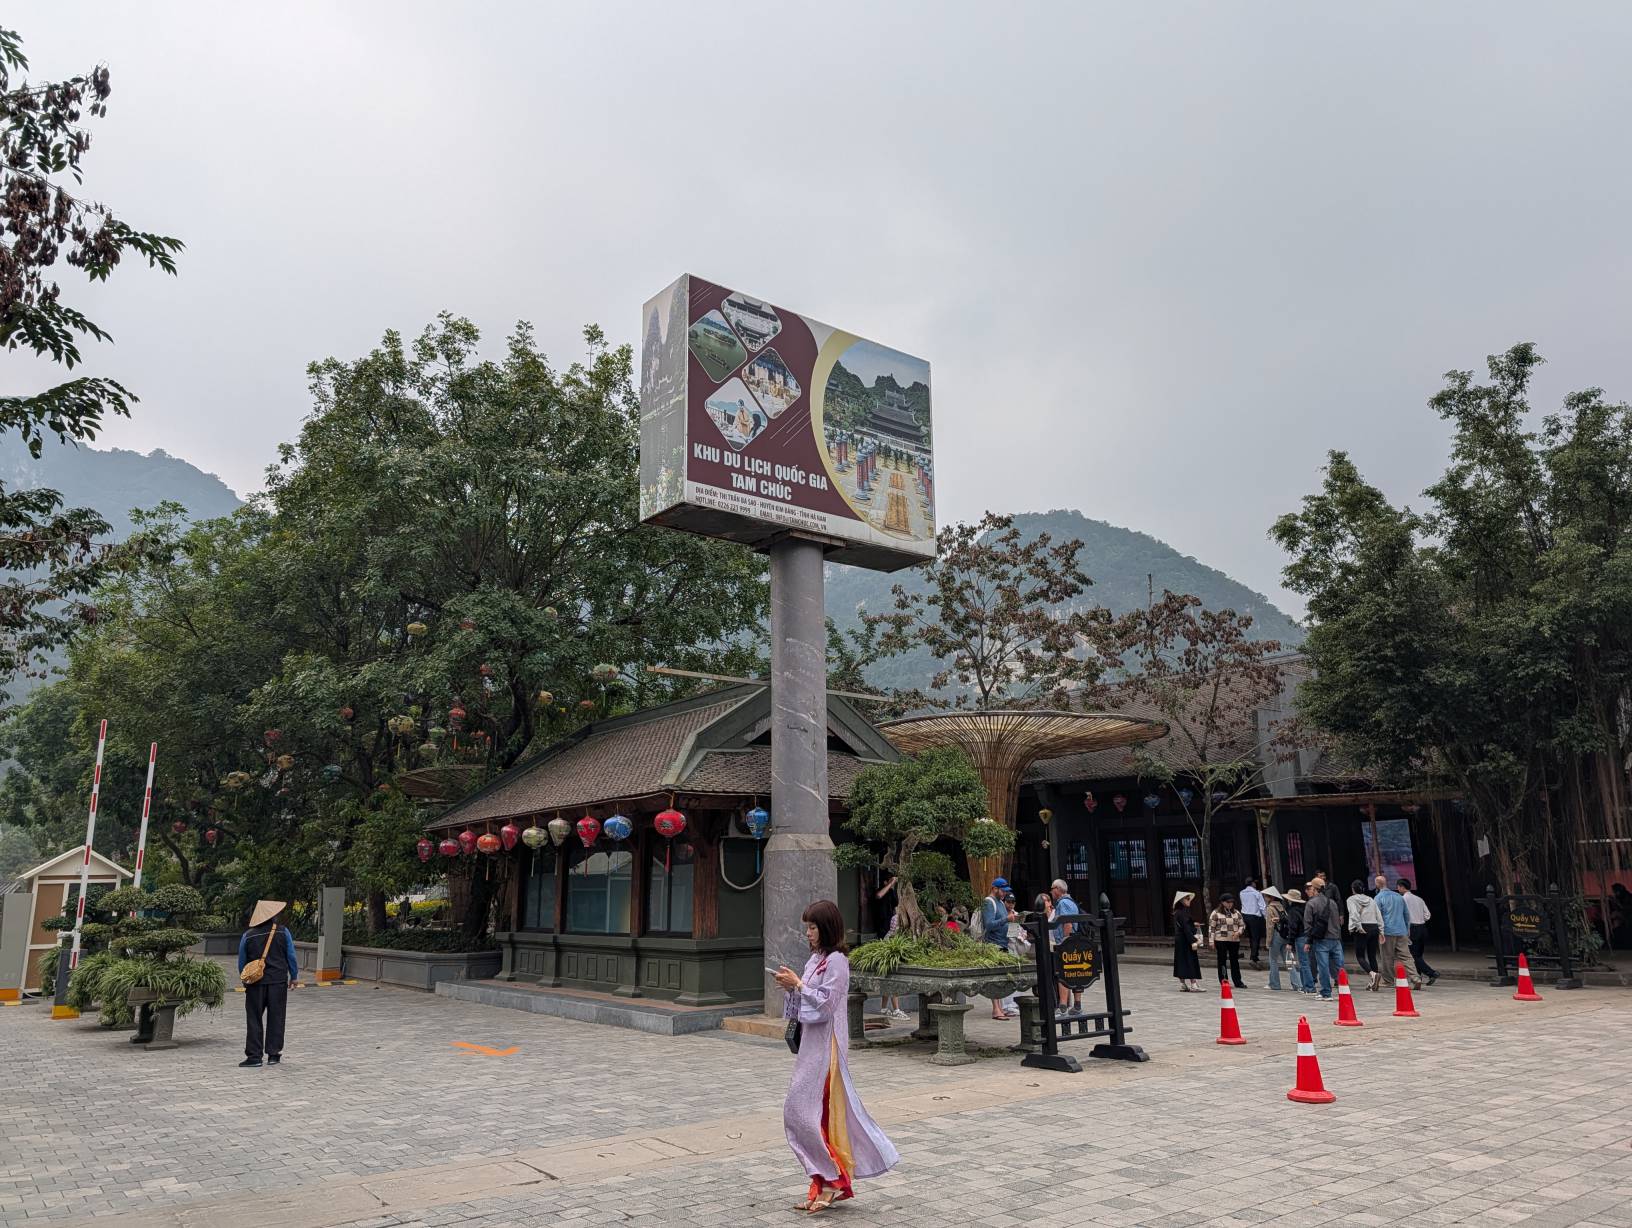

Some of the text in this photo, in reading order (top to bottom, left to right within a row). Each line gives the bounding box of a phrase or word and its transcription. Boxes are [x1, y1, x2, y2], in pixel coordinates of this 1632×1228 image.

[694, 443, 828, 491] KHU DU LỊCH QUỐC GIA
[731, 472, 792, 501] TAM CHÚC
